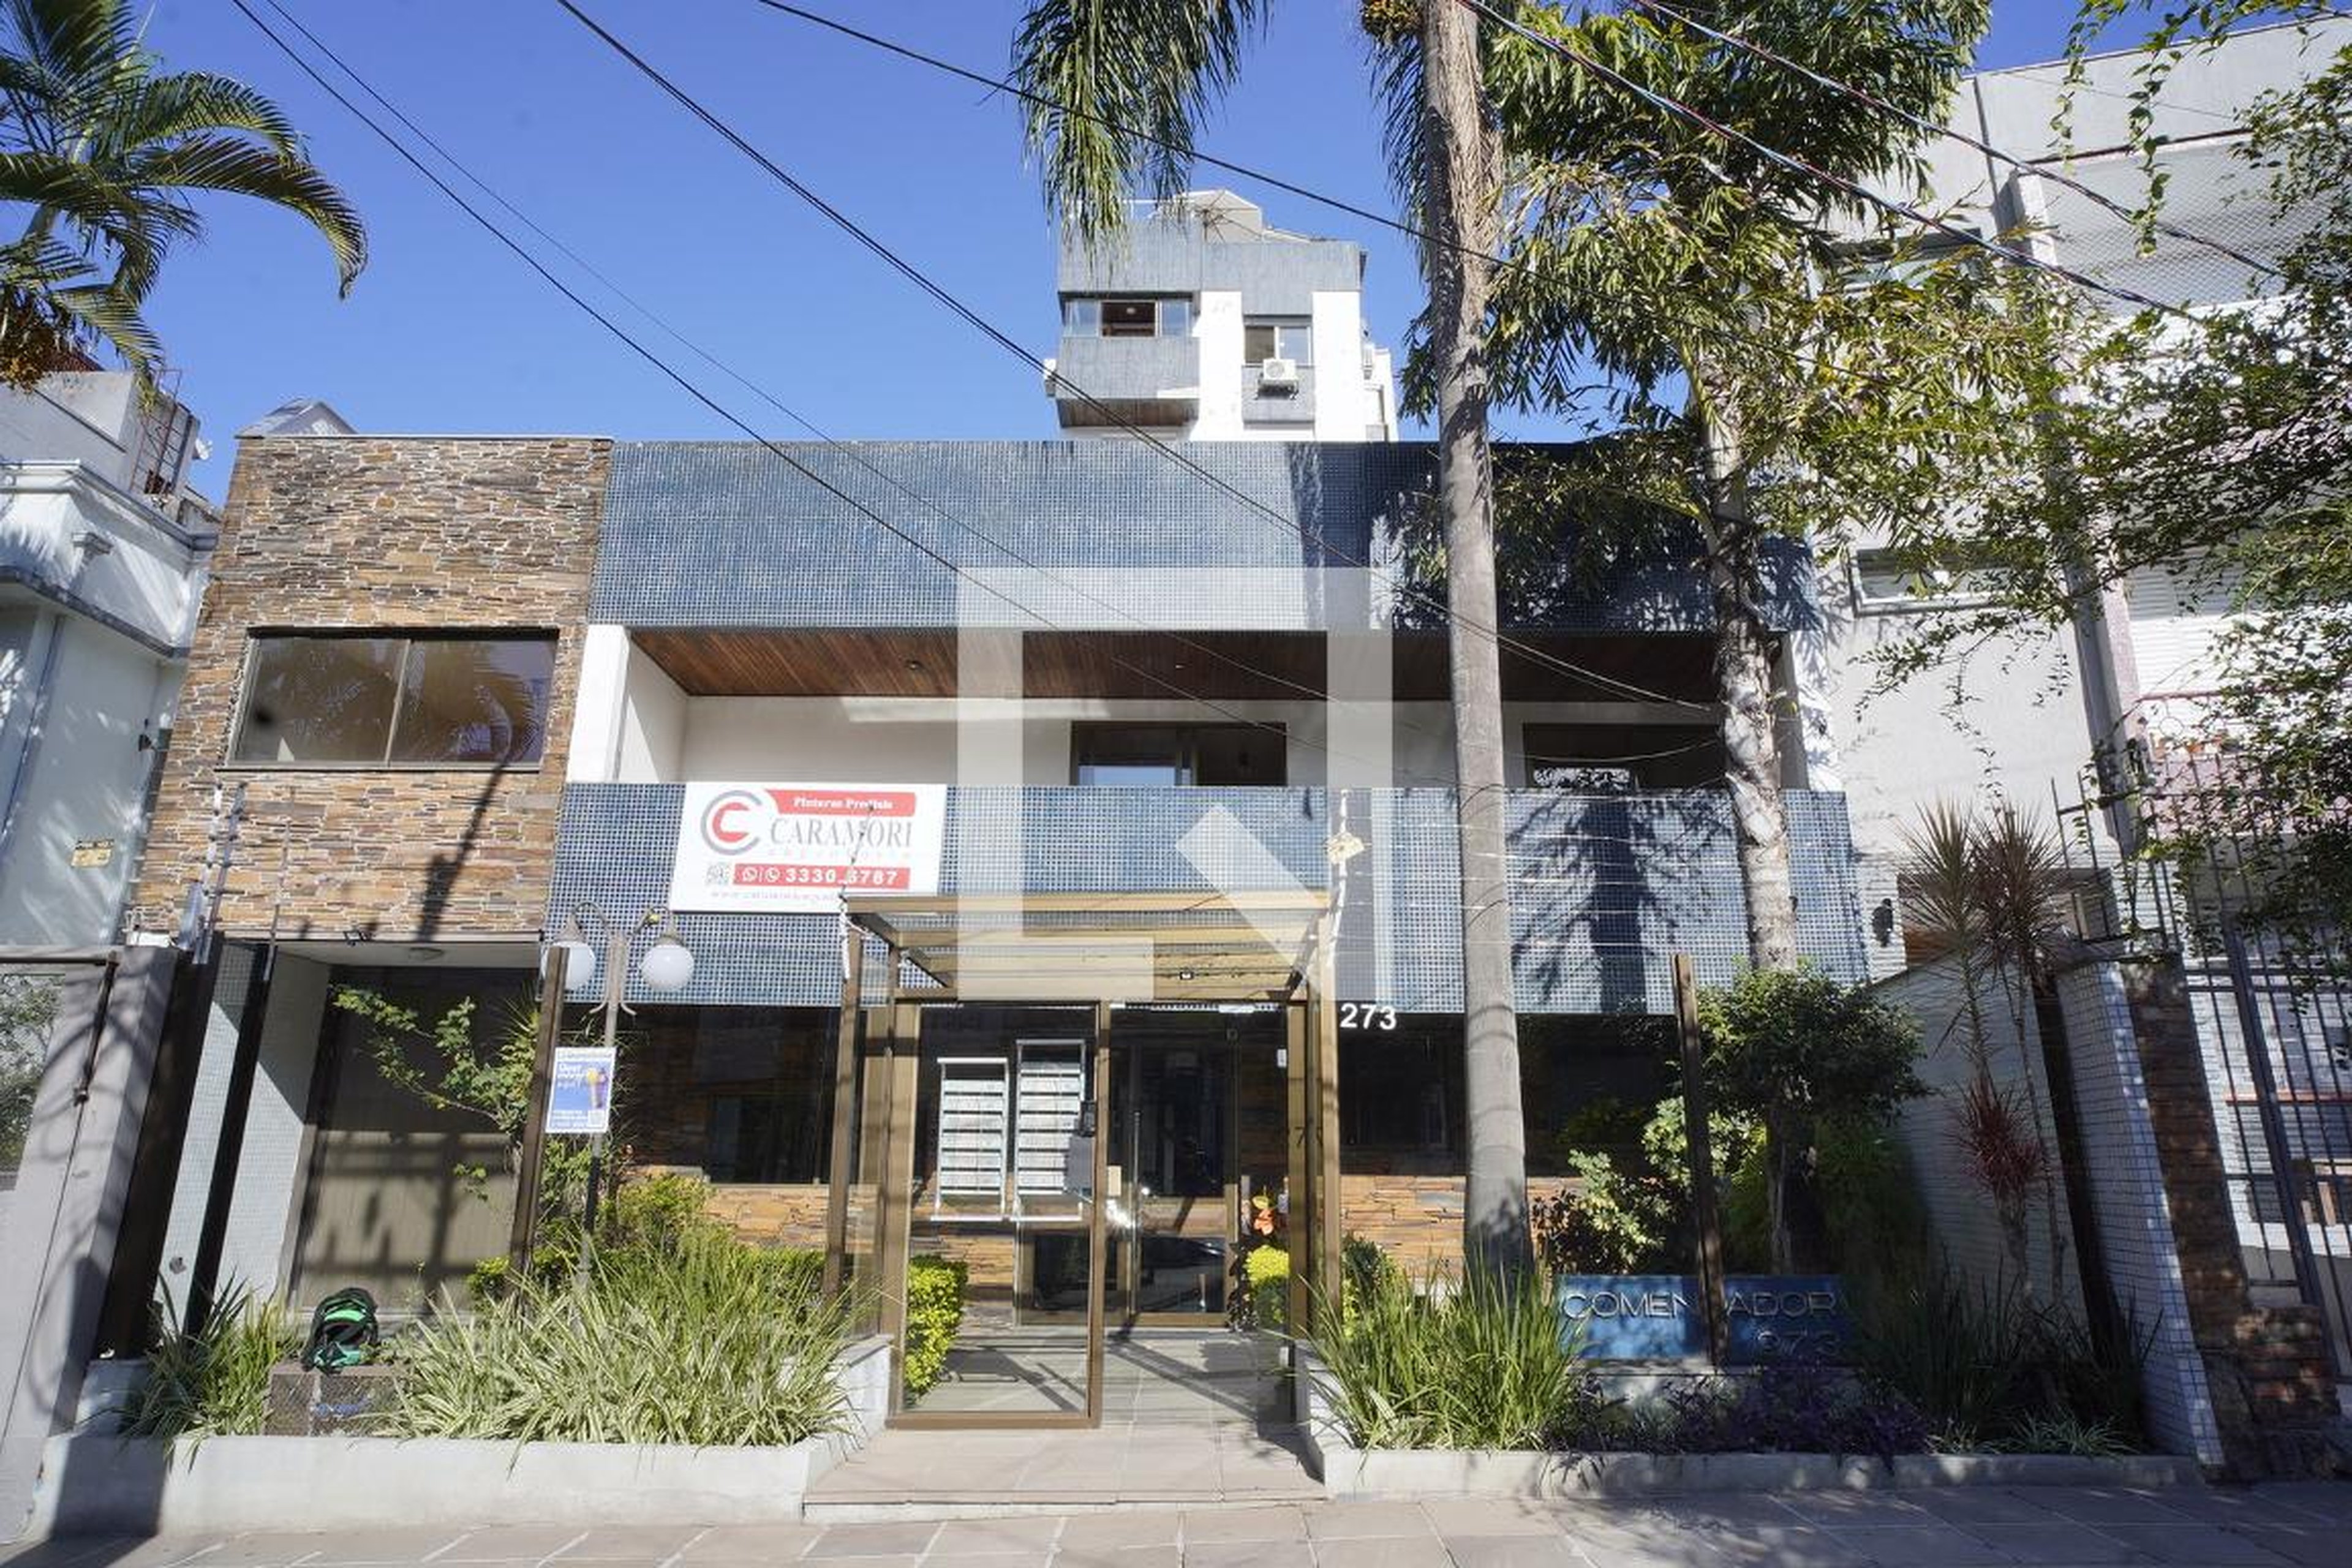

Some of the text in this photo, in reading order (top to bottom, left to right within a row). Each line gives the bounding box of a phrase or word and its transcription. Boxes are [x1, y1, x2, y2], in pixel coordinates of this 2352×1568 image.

[770, 818, 912, 848] CARAMORI
[1340, 1003, 1397, 1030] 273
[1561, 1291, 1837, 1319] COMENADOR
